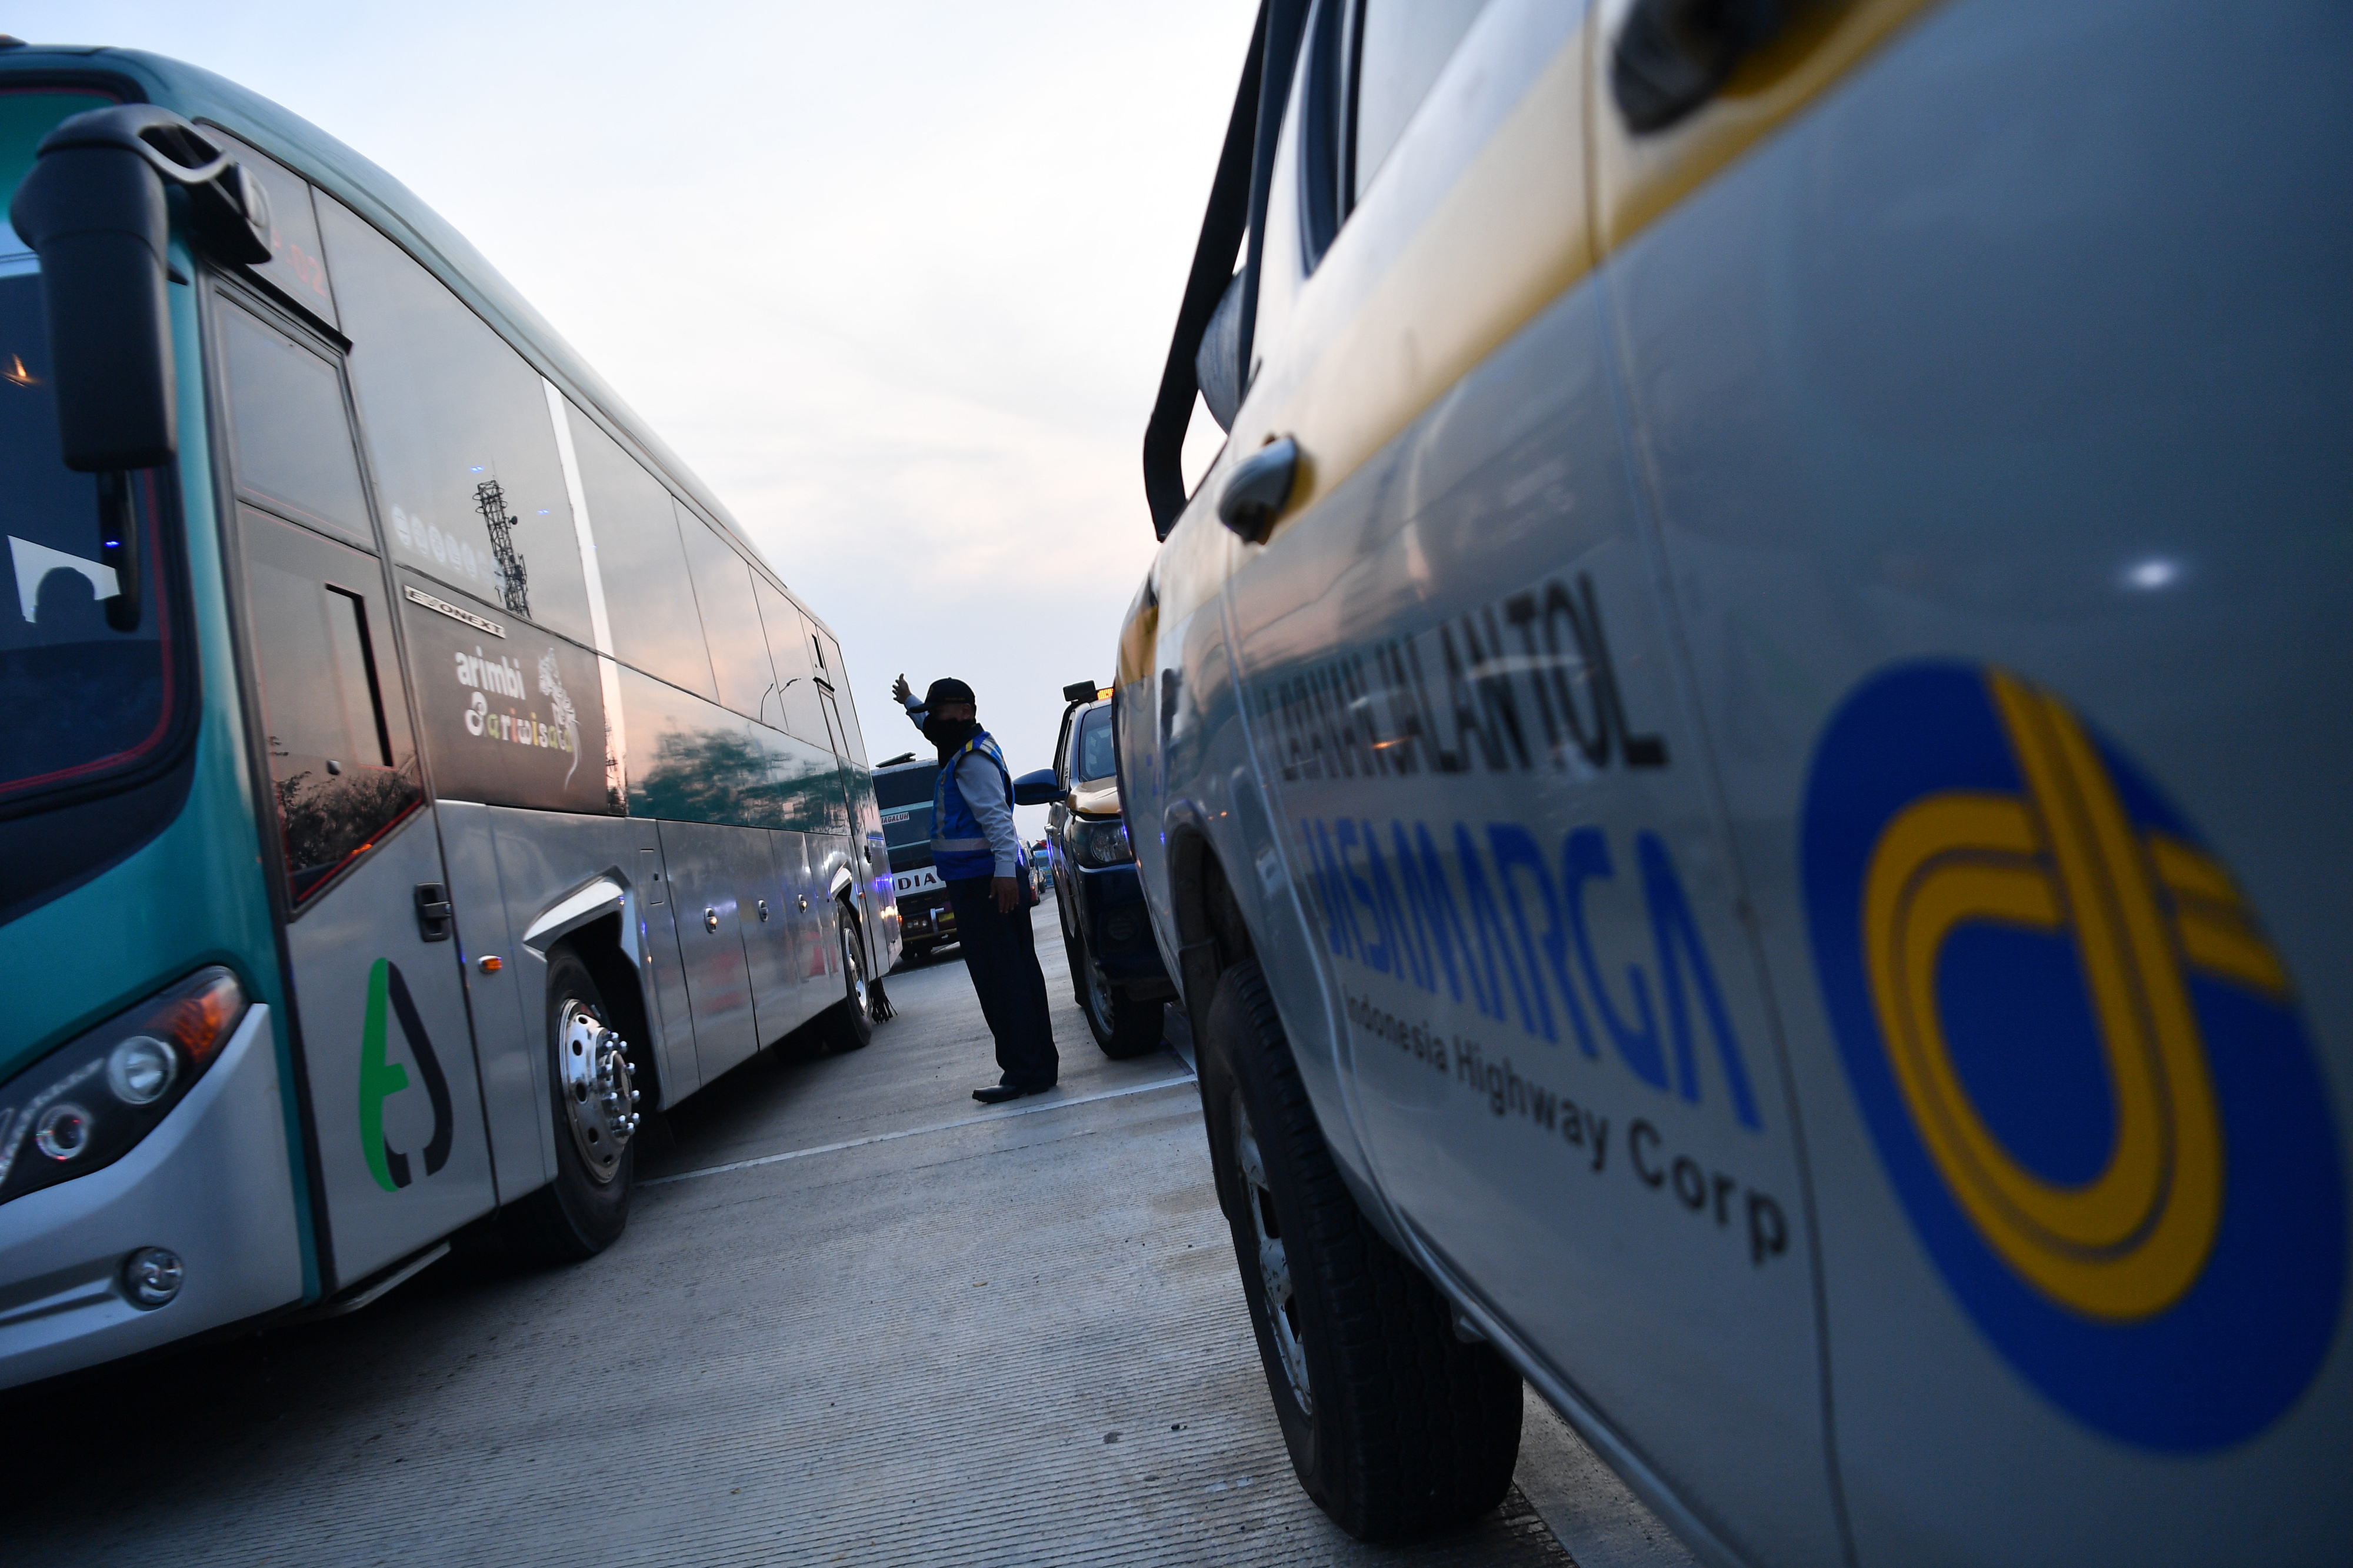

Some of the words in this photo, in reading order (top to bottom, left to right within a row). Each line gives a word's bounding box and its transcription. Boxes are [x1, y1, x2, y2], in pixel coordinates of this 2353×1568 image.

[455, 645, 526, 700] arimbi
[1504, 568, 1668, 772] TOL
[894, 872, 937, 891] DIA
[1343, 984, 1450, 1073] Indonesia
[1453, 1033, 1609, 1173] Highway
[1628, 1117, 1789, 1266] Corp
